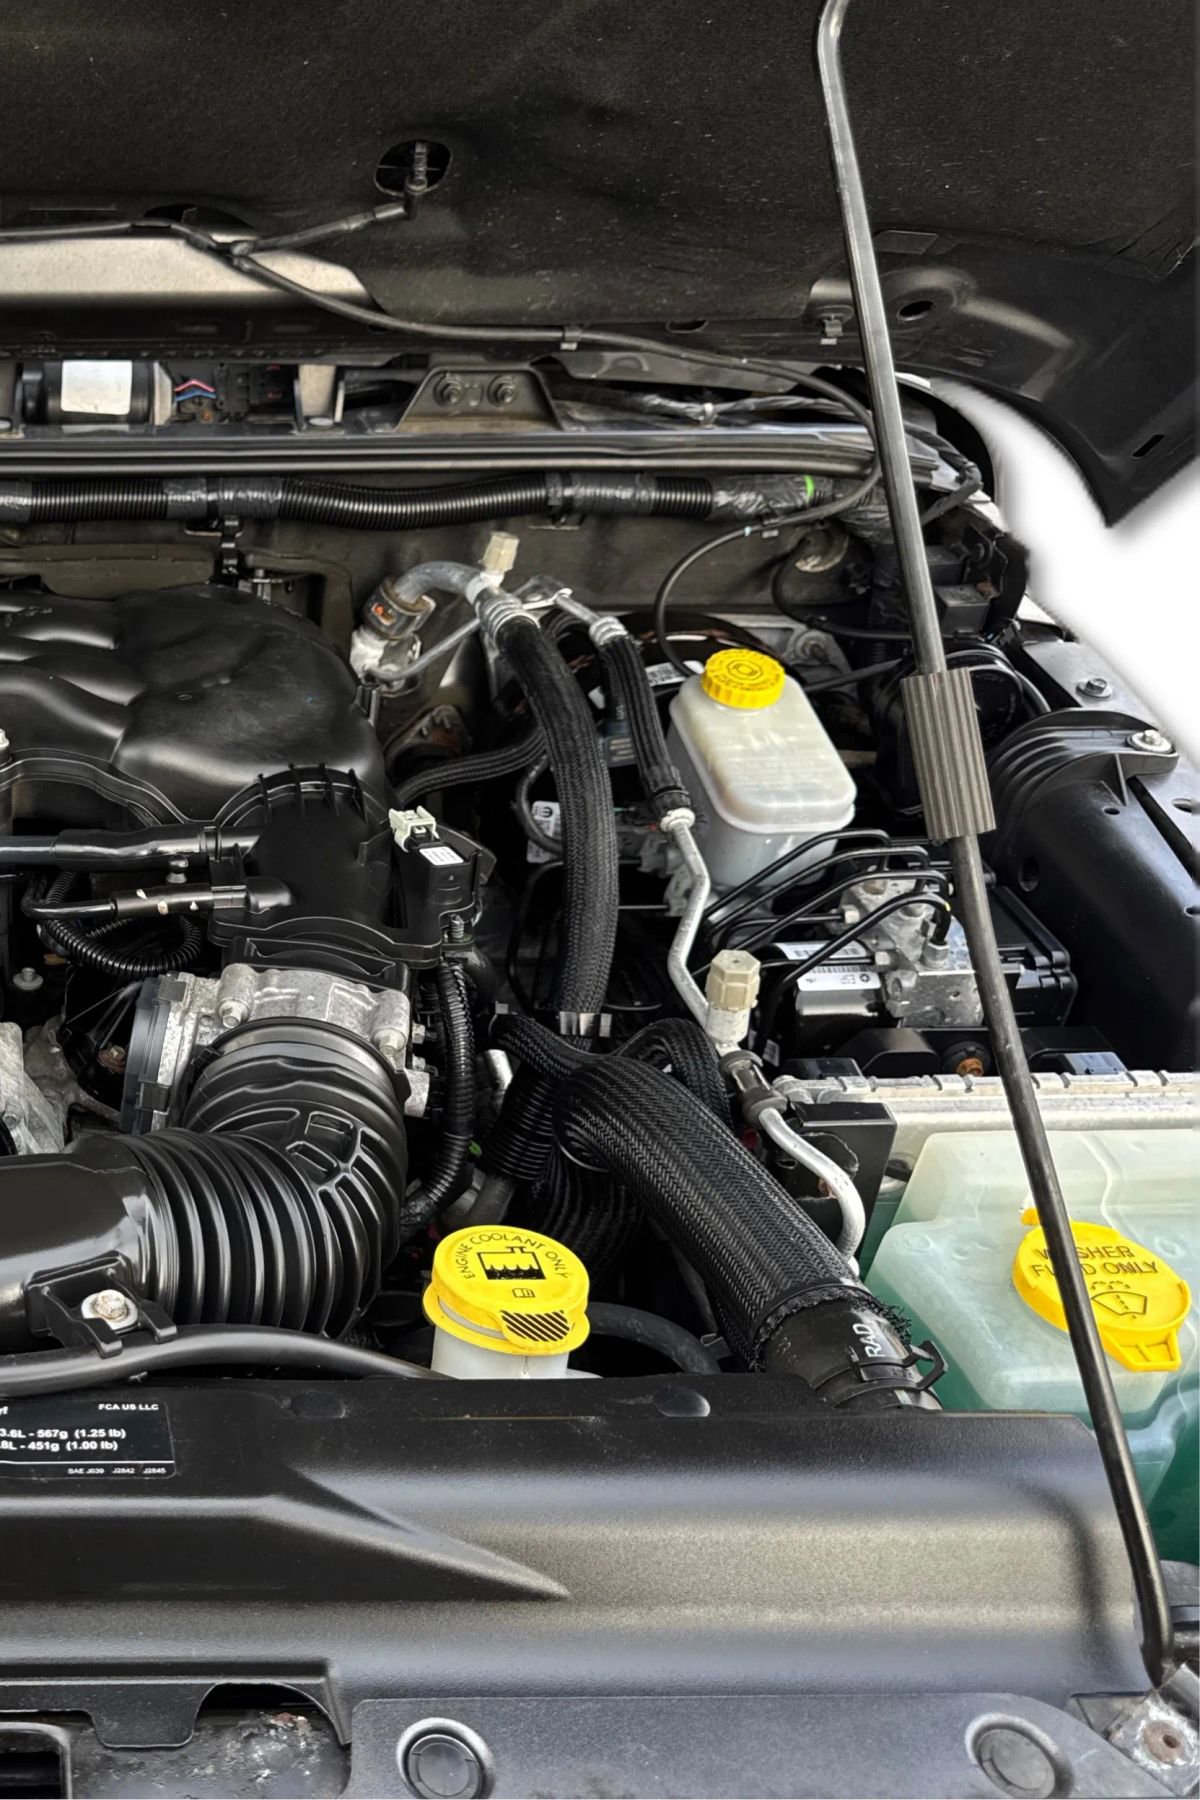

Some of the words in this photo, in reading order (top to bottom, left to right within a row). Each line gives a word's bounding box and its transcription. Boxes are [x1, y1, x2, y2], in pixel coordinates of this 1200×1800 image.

[455, 1243, 476, 1279] ENGINE
[469, 1232, 546, 1249] COOLANT
[545, 1251, 569, 1279] ONLY
[1035, 1245, 1135, 1260] WSHER
[1032, 1262, 1097, 1276] FLD
[1102, 1261, 1159, 1275] ONLY
[853, 1323, 886, 1358] RAD
[98, 1403, 120, 1411] FCA
[121, 1403, 137, 1411] US
[138, 1403, 159, 1411] LLC
[36, 1429, 68, 1440] 567g
[74, 1428, 106, 1439] (1.25
[108, 1428, 127, 1439] lb)
[27, 1441, 60, 1452] 451g
[66, 1440, 98, 1451] (1.00
[100, 1440, 119, 1451] lb)
